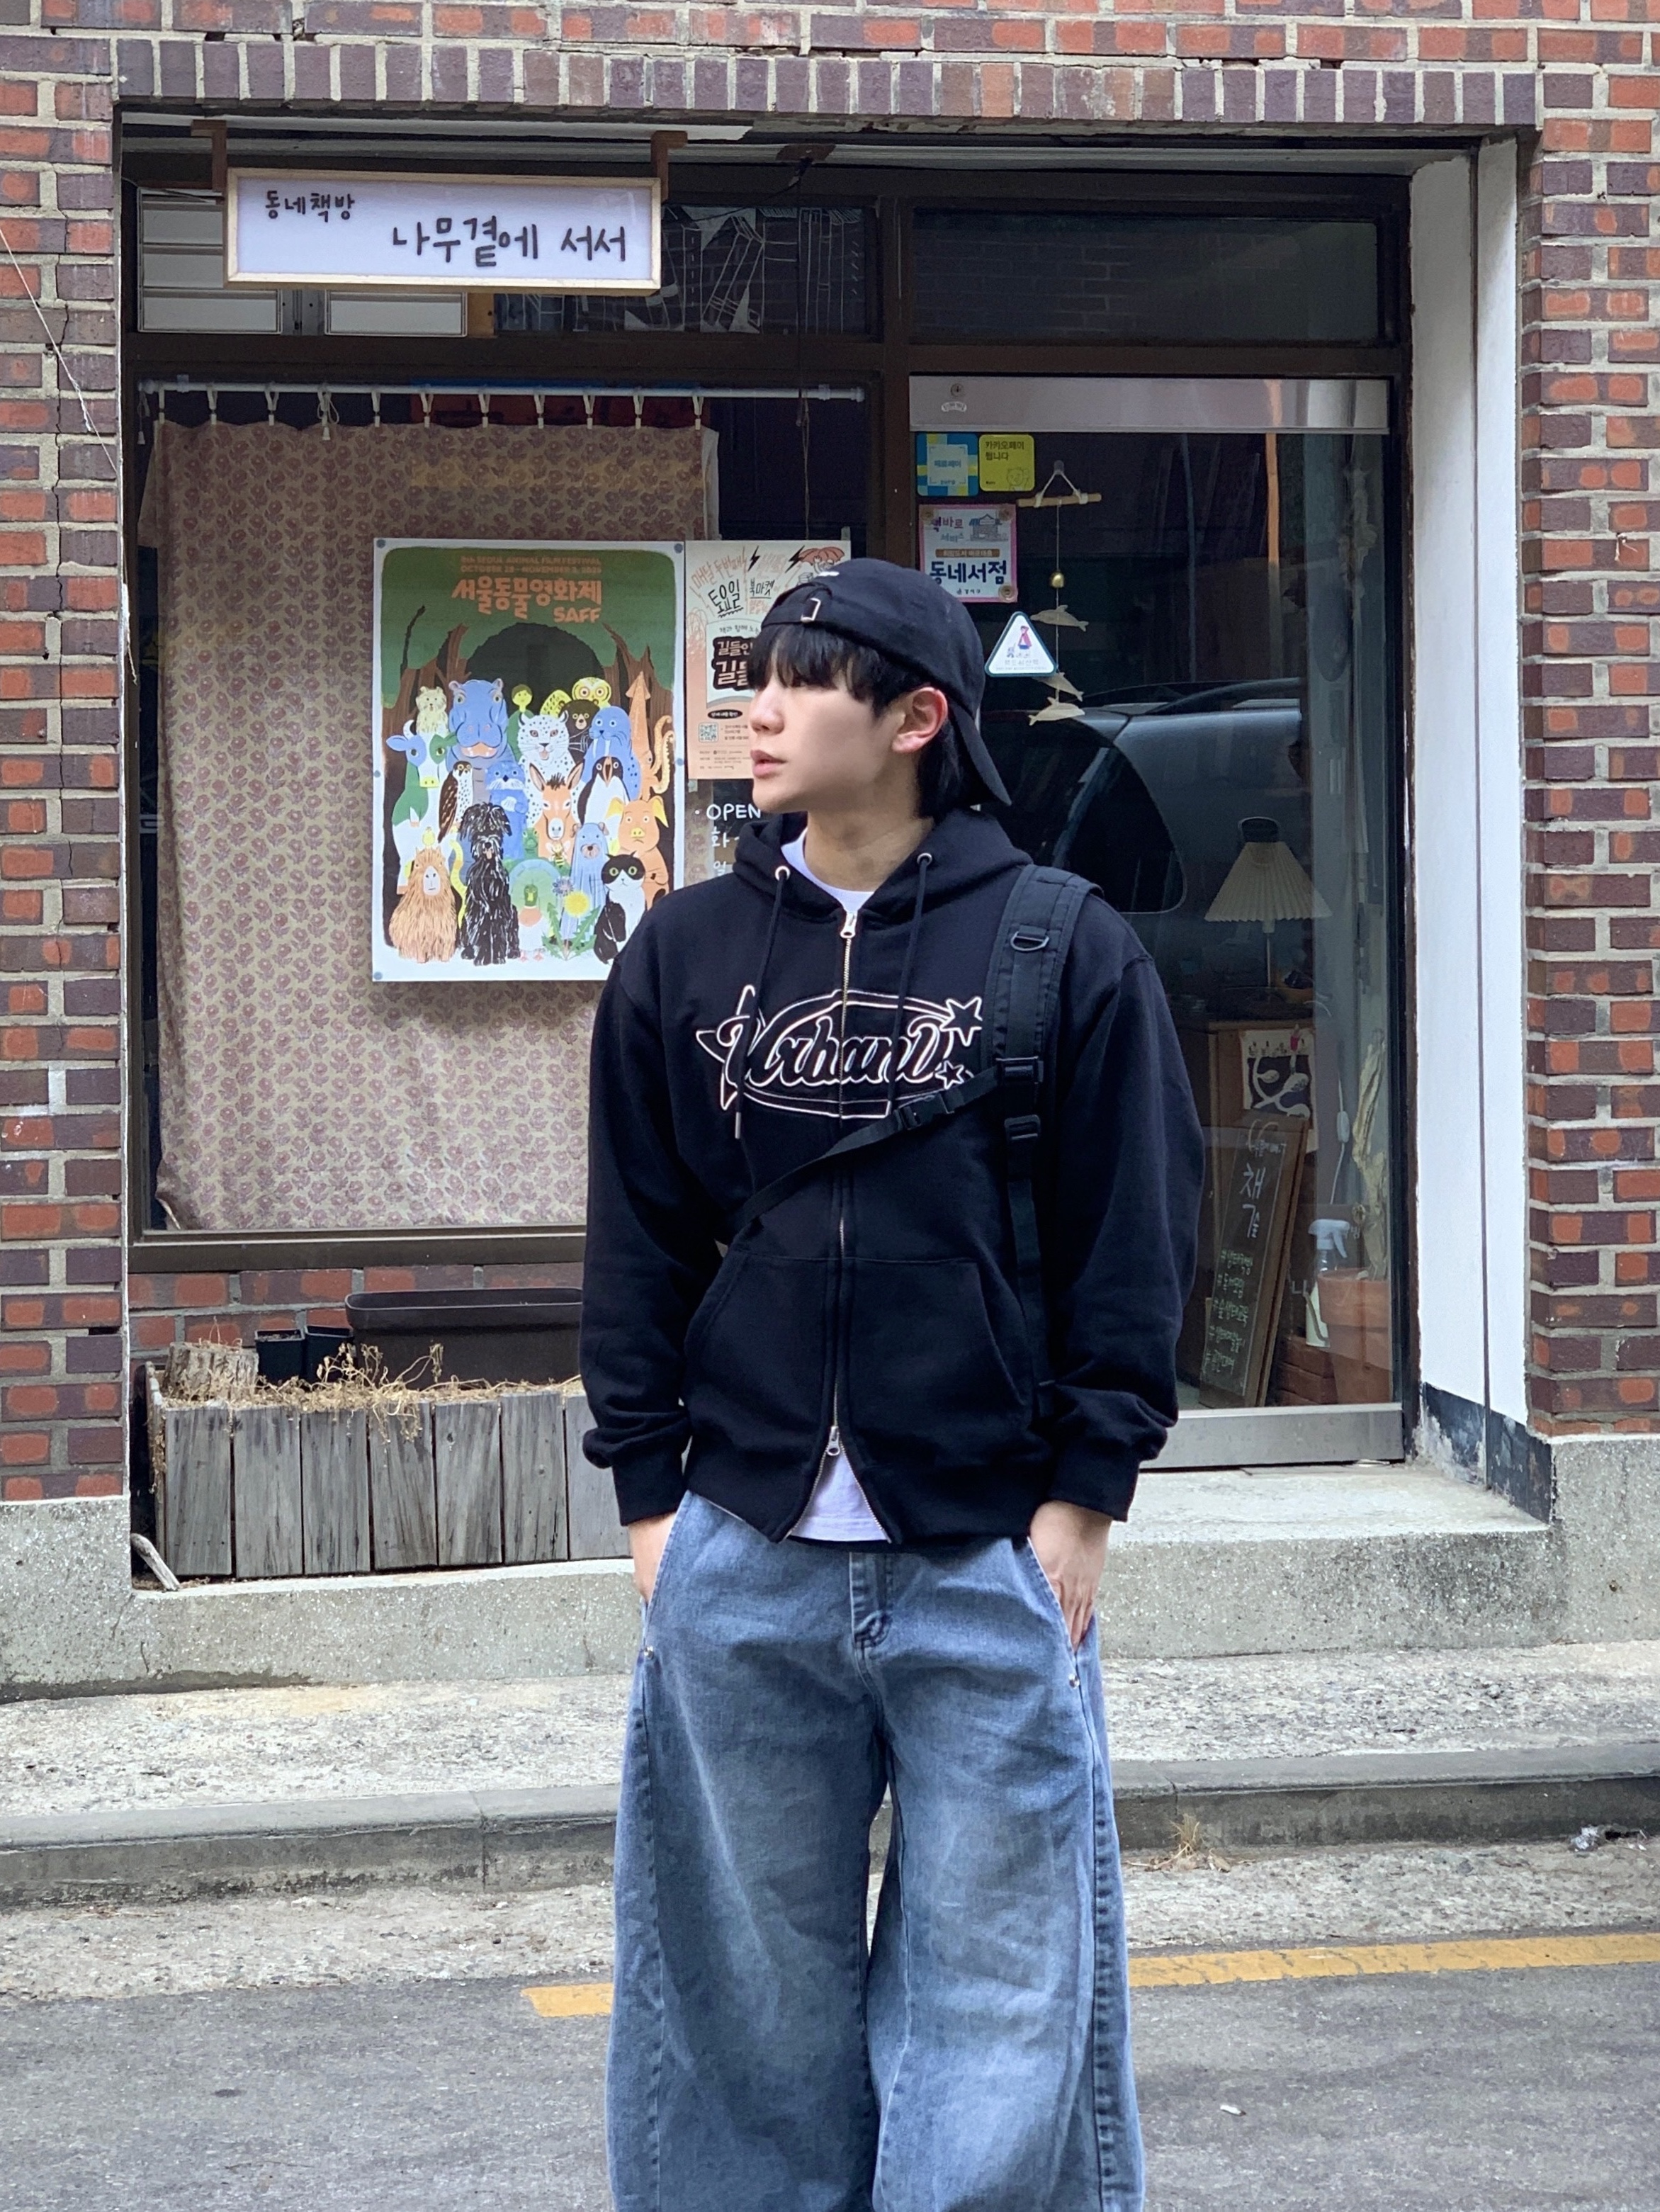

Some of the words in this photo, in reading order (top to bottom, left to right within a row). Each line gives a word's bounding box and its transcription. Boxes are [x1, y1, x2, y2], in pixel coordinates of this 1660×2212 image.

[265, 190, 355, 223] 동네책방
[393, 215, 538, 267] 나무곁에
[560, 225, 627, 262] 서서
[985, 441, 1025, 451] 카카오페이
[985, 451, 1009, 461] 됩니다
[929, 560, 1007, 585] 동네서점
[453, 575, 602, 620] 서울동물영화제
[708, 578, 742, 615] 토요일
[749, 577, 776, 597] 북마켓
[553, 606, 602, 623] SAFF
[706, 803, 762, 822] OPEN
